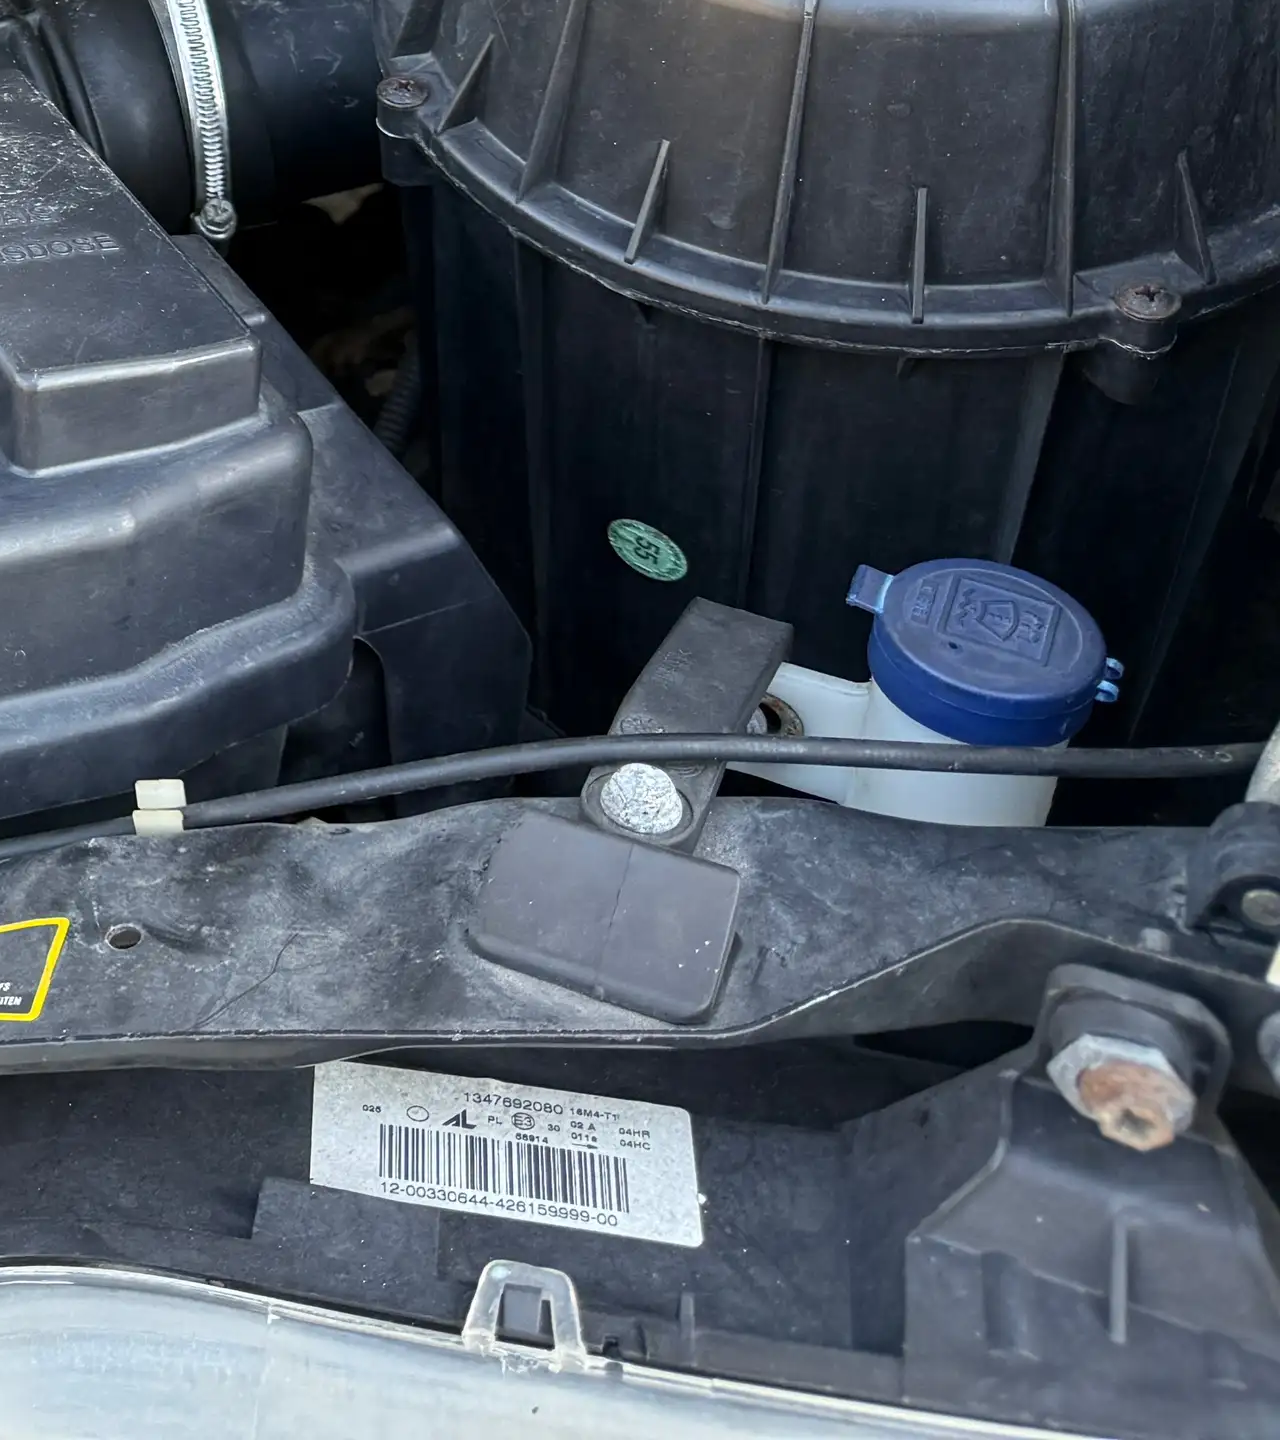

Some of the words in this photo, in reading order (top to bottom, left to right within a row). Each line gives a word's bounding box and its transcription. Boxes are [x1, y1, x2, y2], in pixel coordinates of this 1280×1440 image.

[634, 535, 660, 565] 55
[464, 1092, 563, 1115] 1347692080
[487, 1115, 503, 1125] PL
[513, 1114, 532, 1127] E3
[547, 1123, 561, 1132] 30
[570, 1121, 584, 1130] 02
[587, 1123, 597, 1131] A
[618, 1127, 651, 1138] 04HR
[619, 1139, 651, 1150] 04HC
[381, 1181, 618, 1227] 12-00330644-426159999-00
